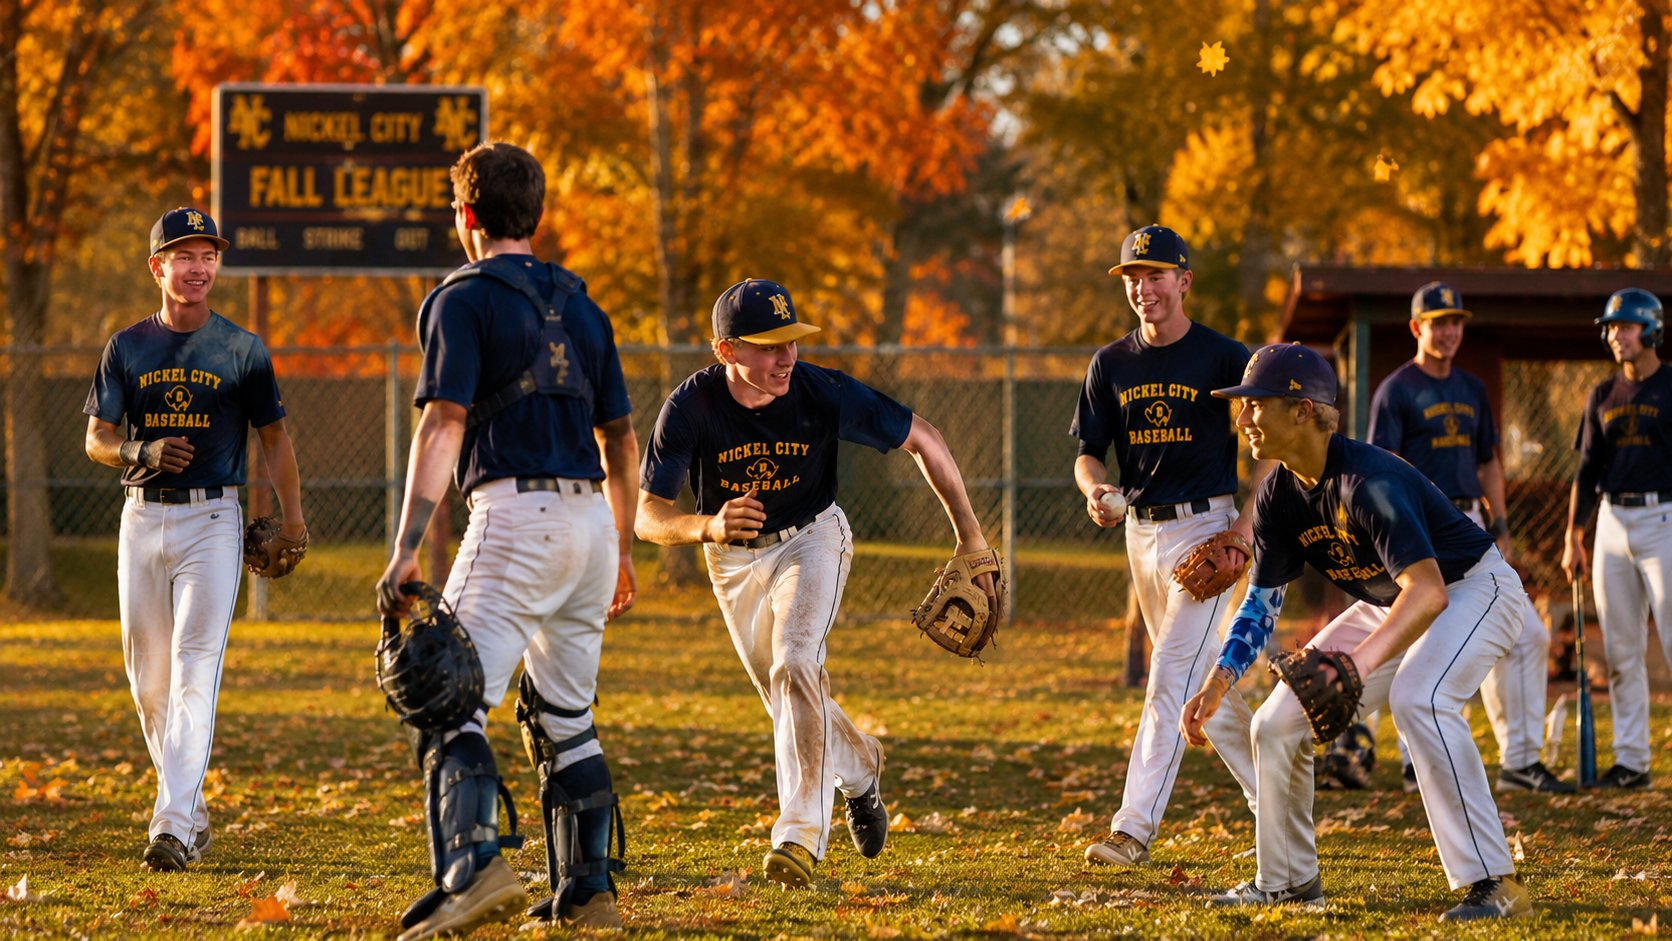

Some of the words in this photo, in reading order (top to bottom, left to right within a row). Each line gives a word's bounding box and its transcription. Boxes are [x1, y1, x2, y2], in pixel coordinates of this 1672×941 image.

[370, 113, 423, 142] CITY
[250, 165, 323, 207] FALL
[333, 166, 450, 208] LEAGUE
[139, 368, 187, 389] NICKEL
[190, 369, 222, 390] CITY
[1119, 383, 1166, 408] NICKEL
[1168, 383, 1199, 402] CITY
[145, 413, 211, 428] BASEBALL
[1128, 427, 1193, 445] BASEBALL
[717, 442, 770, 463] NICKEL
[775, 441, 810, 456] CITY
[720, 475, 800, 493] BASEBALL
